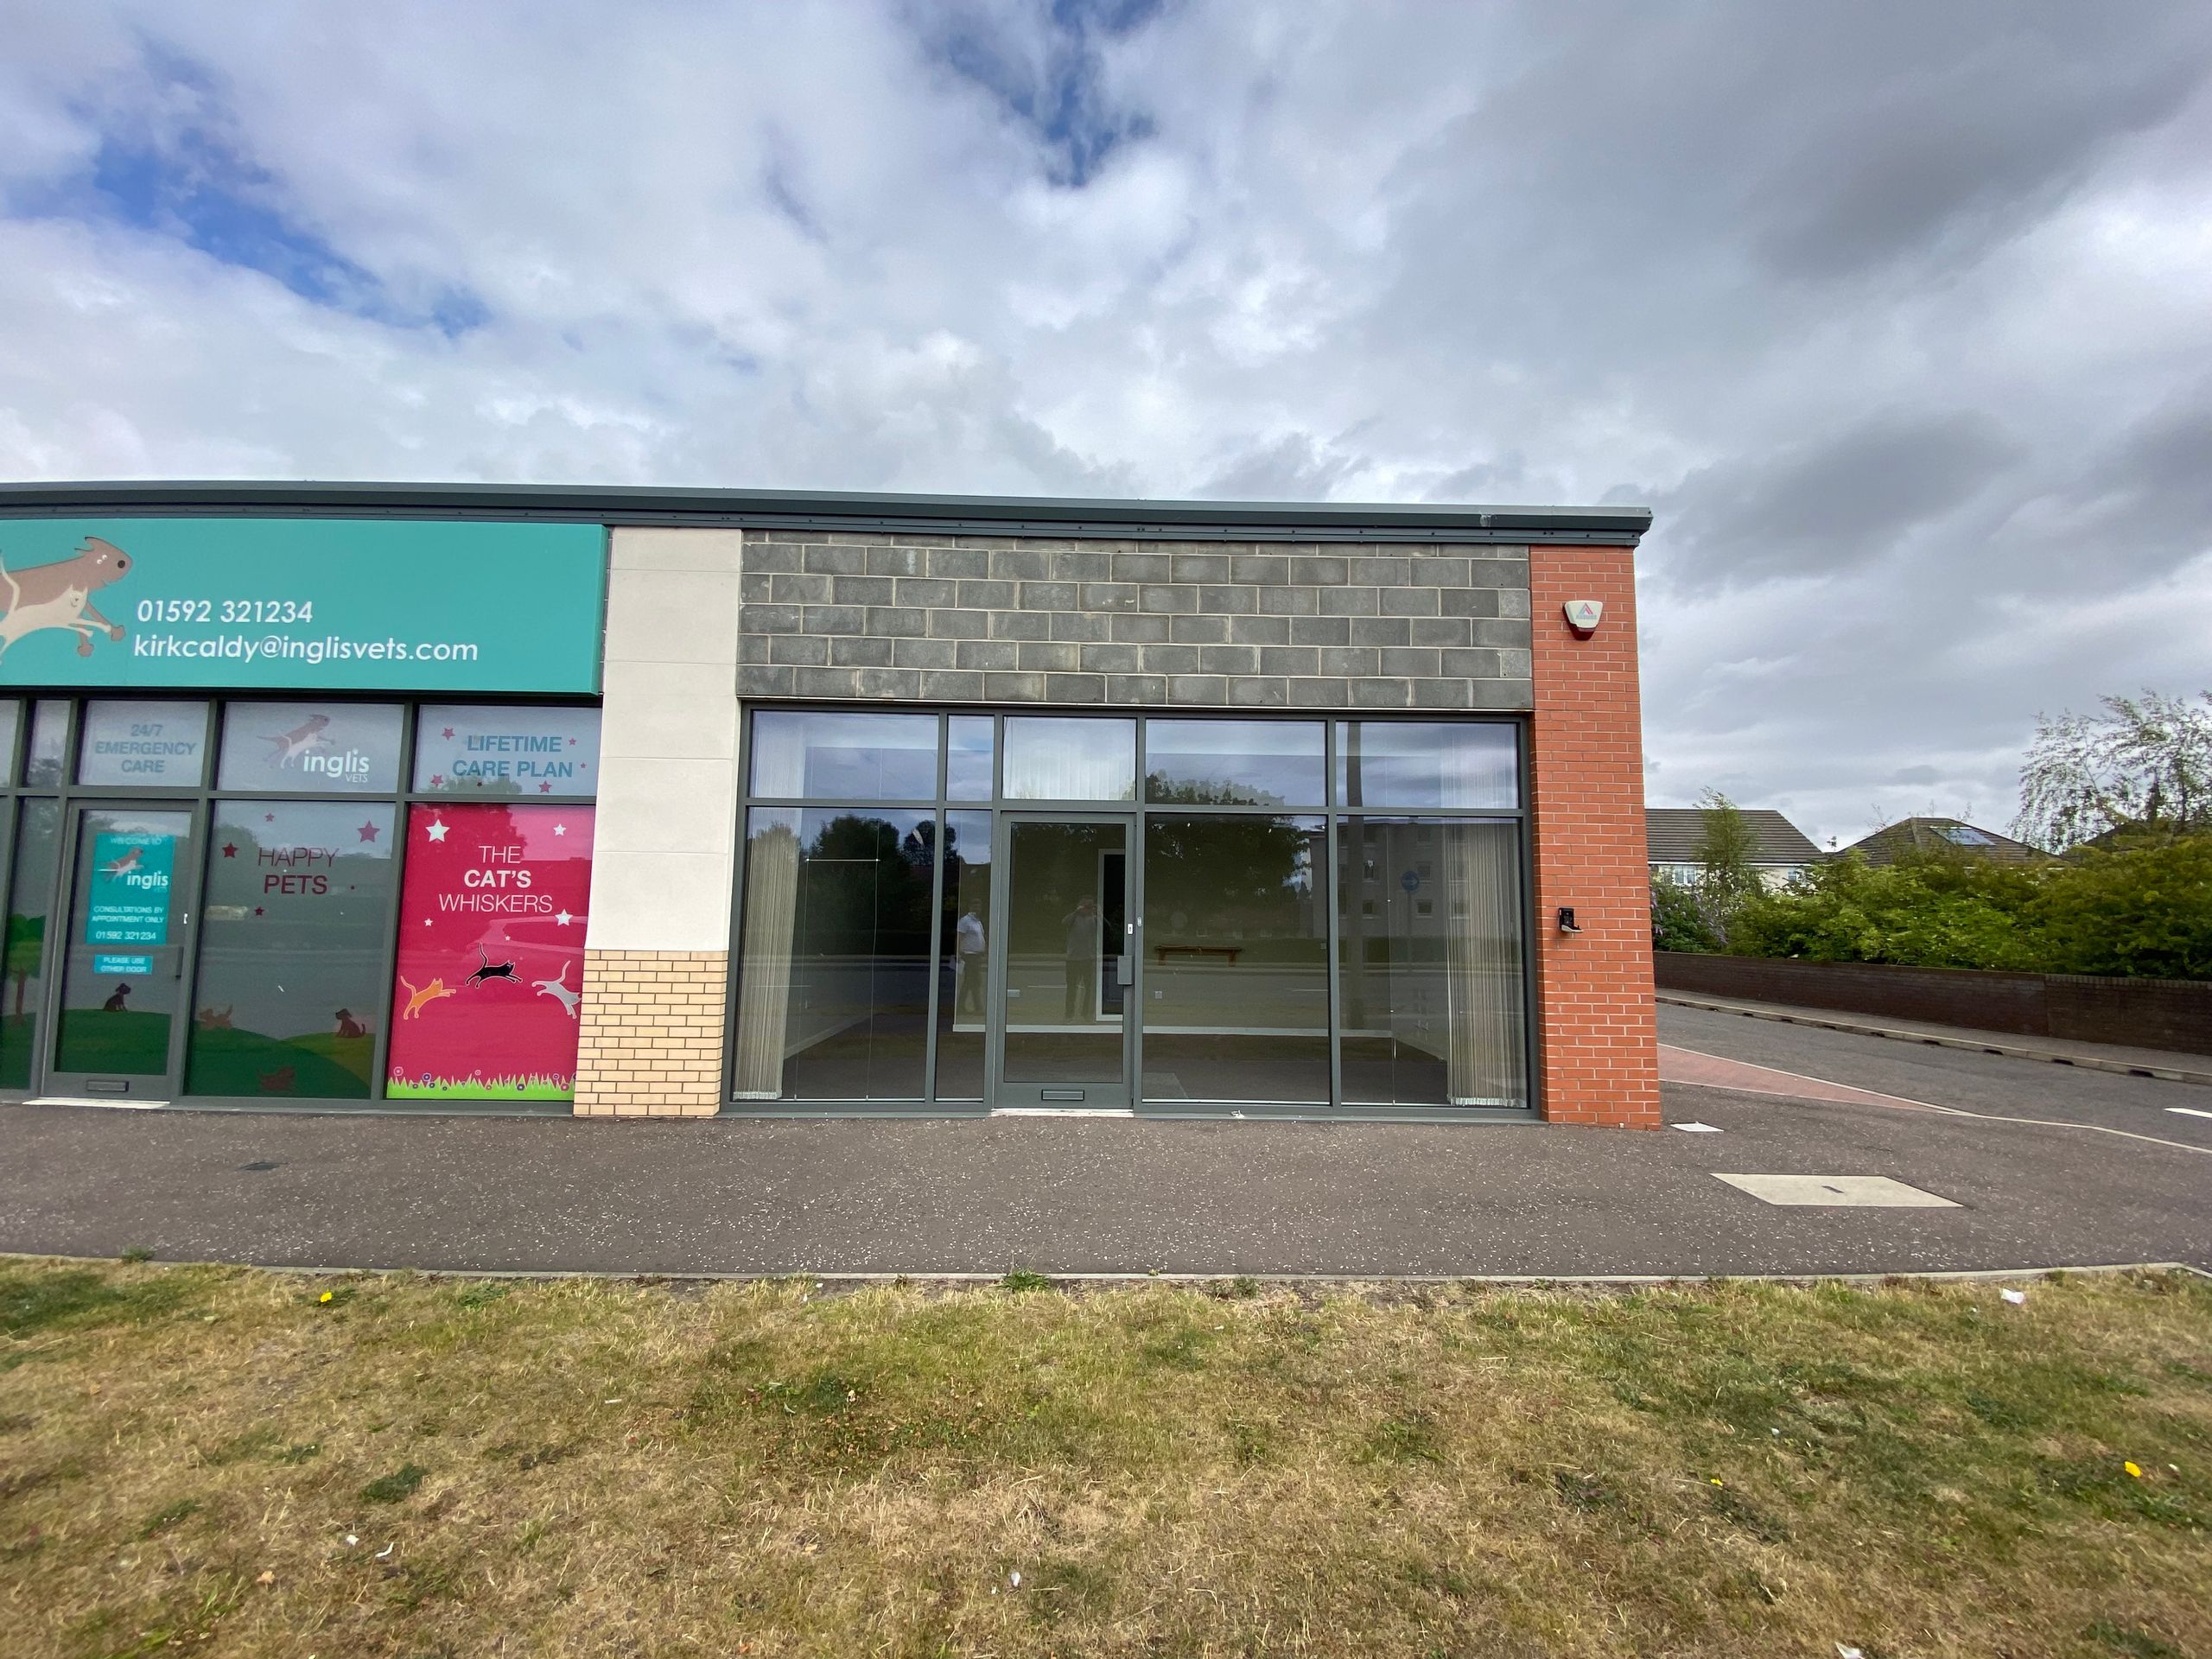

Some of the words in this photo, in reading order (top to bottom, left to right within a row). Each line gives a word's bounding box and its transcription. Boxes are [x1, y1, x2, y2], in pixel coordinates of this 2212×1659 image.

[137, 600, 212, 622] 01592
[219, 600, 314, 624] 321234
[133, 634, 480, 664] kirkcaldy@inglisvets.com
[130, 723, 163, 736] 24/7
[94, 741, 197, 755] EMERGENCY
[467, 734, 563, 753] LIFETIME
[121, 760, 165, 772] CARE
[303, 748, 371, 778] inglis
[452, 760, 510, 777] CARE
[518, 760, 573, 778] PLAN
[346, 773, 368, 783] VETS
[111, 836, 149, 845] WELCOME
[258, 846, 340, 867] HAPPY
[478, 845, 521, 864] THE
[126, 870, 168, 889] inglis
[264, 874, 327, 895] PETS
[93, 906, 152, 914] CONSULTATIONS
[438, 893, 553, 913] WHISKERS
[95, 931, 123, 940] 01592
[124, 931, 156, 941] 321234
